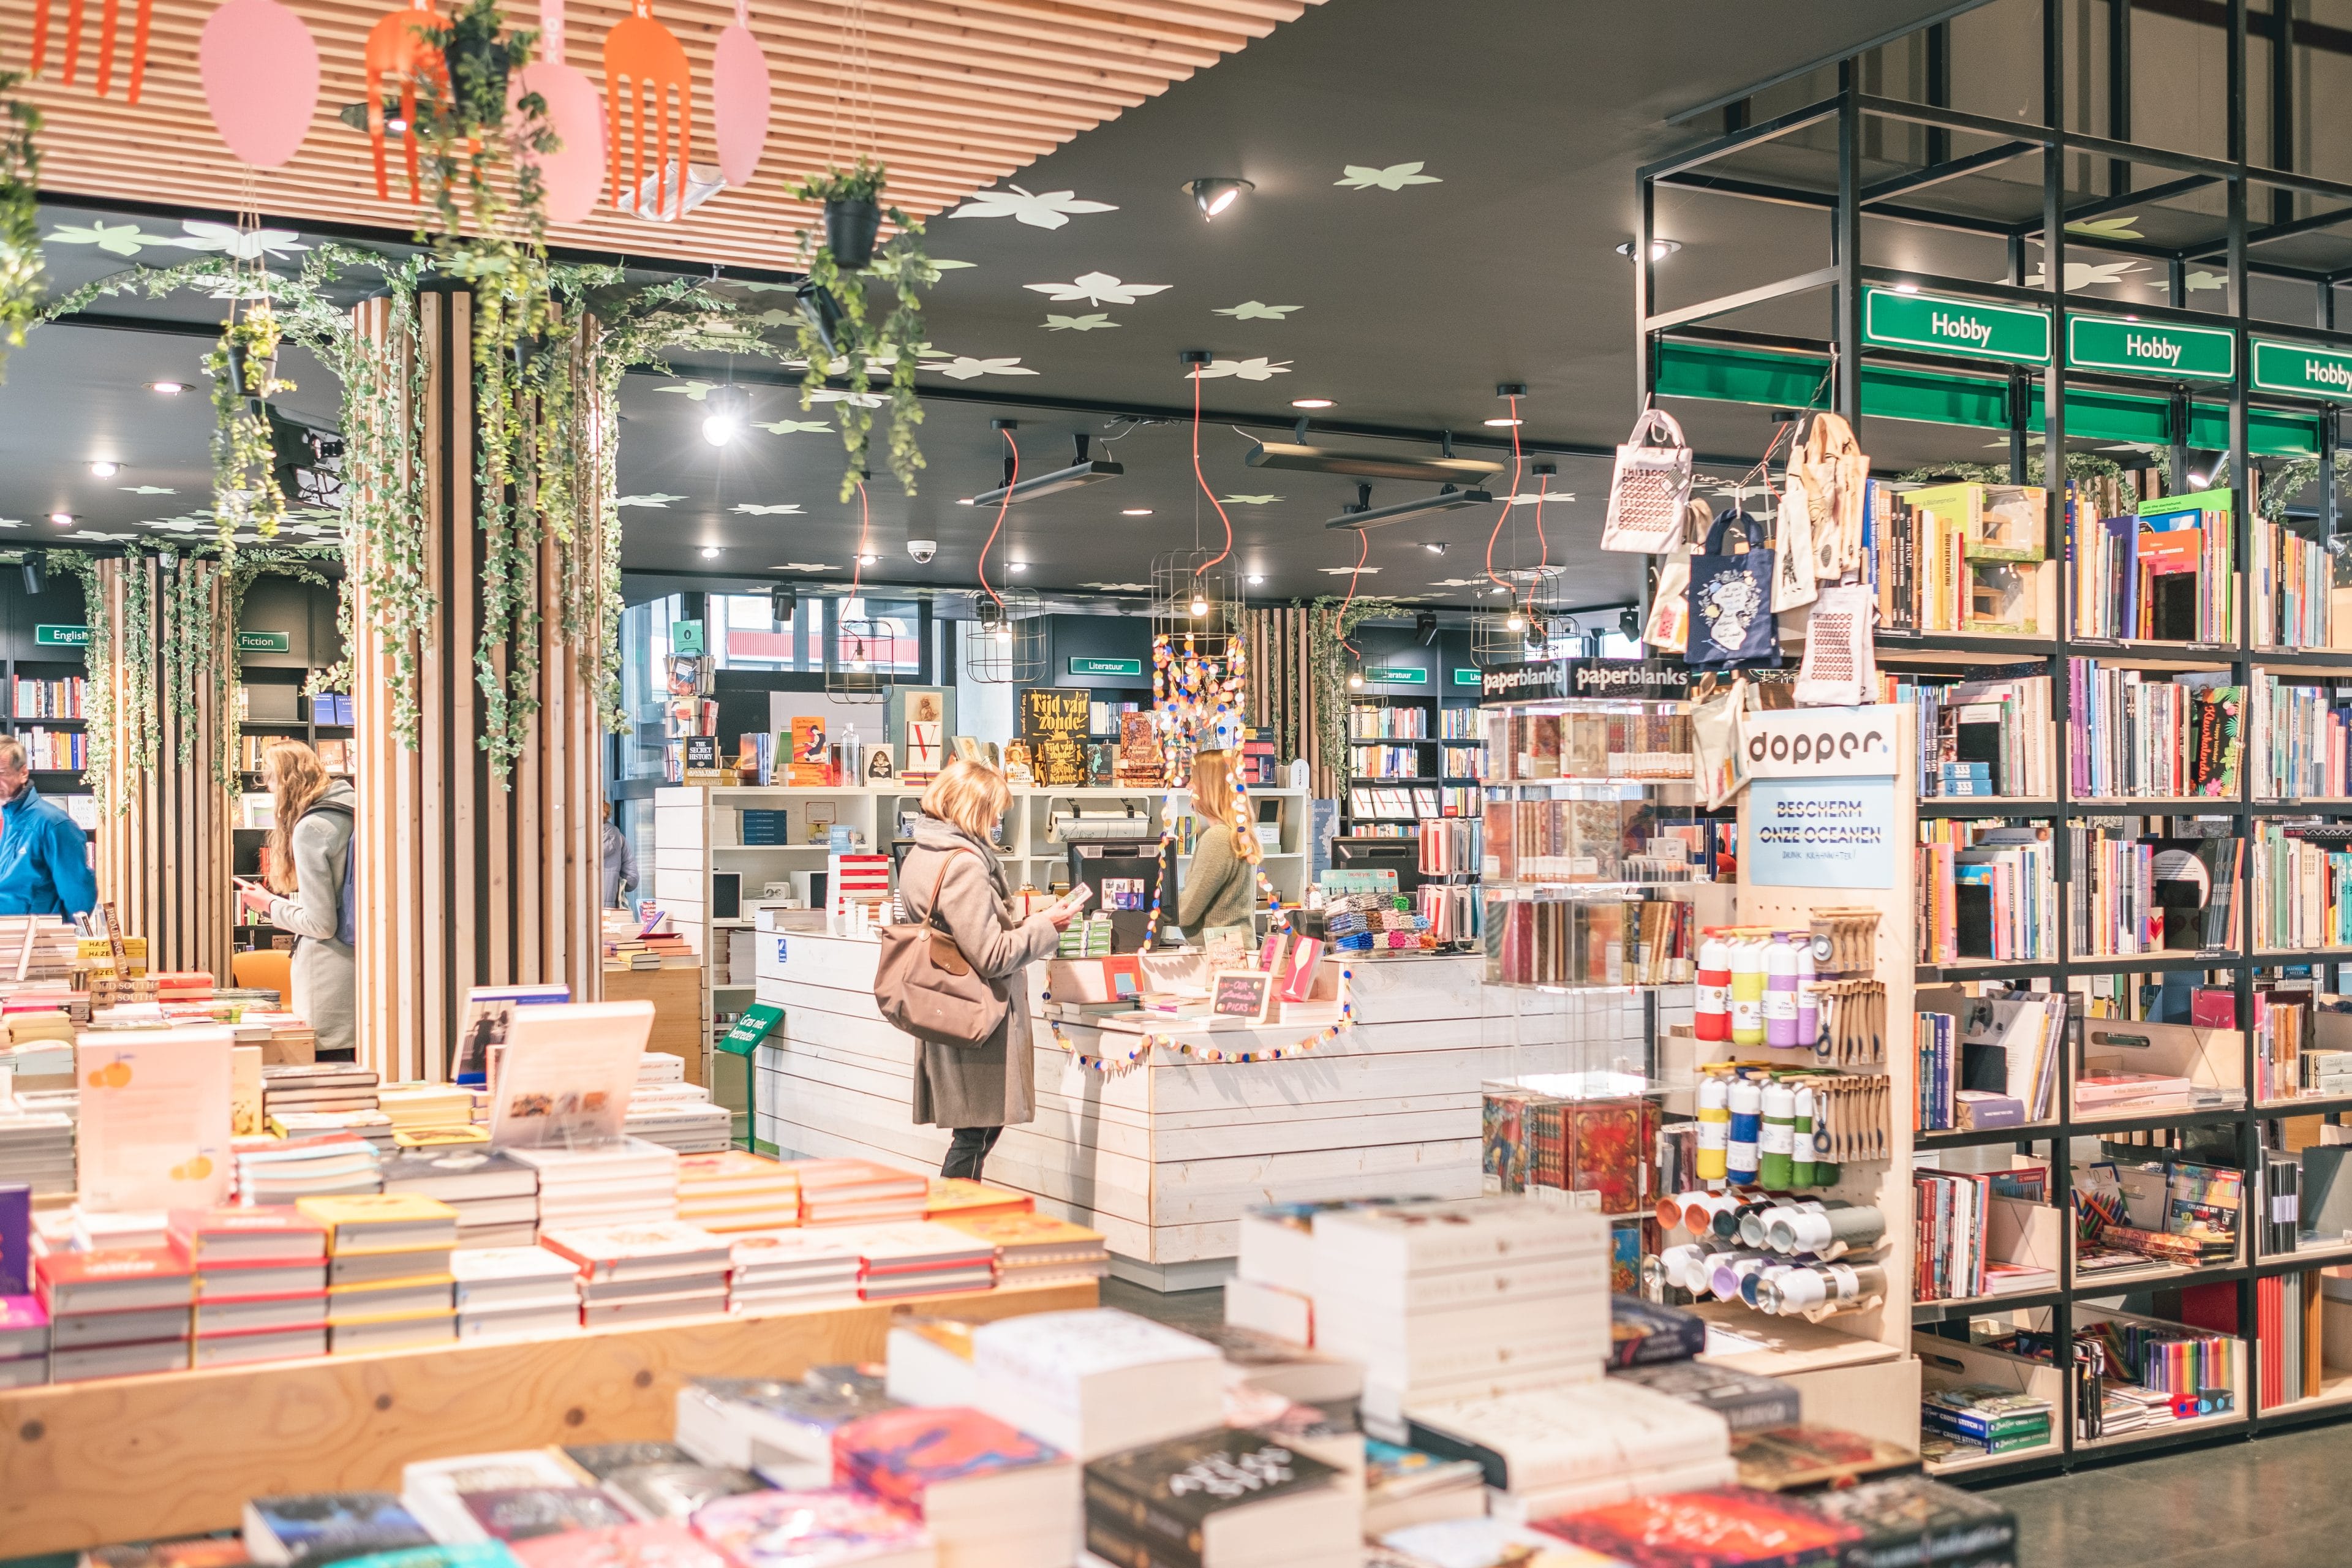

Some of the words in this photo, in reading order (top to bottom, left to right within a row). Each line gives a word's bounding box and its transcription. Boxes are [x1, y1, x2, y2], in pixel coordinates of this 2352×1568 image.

[1932, 313, 1992, 347] Hobby
[2127, 335, 2182, 366] Hobby
[242, 636, 274, 646] Fiction
[1088, 662, 1124, 671] Literatuur
[1483, 666, 1563, 696] paperblanks
[1576, 666, 1688, 691] paperblanks
[1031, 691, 1060, 716] Tijd
[1063, 697, 1088, 714] van
[1039, 714, 1080, 730] zonde
[911, 725, 939, 763] V
[1749, 731, 1882, 764] dopper
[2198, 705, 2215, 782] Kleurkalender
[1777, 801, 1862, 818] BESCHERM
[1760, 827, 1800, 843] ONZE
[1804, 826, 1881, 844] OCEANEN
[106, 908, 120, 940] PROUD
[113, 941, 128, 974] SOUTH
[119, 981, 154, 990] SOUTH
[1226, 1002, 1248, 1012] PICKS
[739, 1014, 755, 1028] Gras
[753, 1018, 767, 1030] niet
[729, 1028, 756, 1042] betreden
[1939, 1413, 1956, 1423] CROSS
[1958, 1417, 1978, 1430] STITCH
[1943, 1431, 1961, 1441] CROSS
[1961, 1435, 1981, 1446] STITCH
